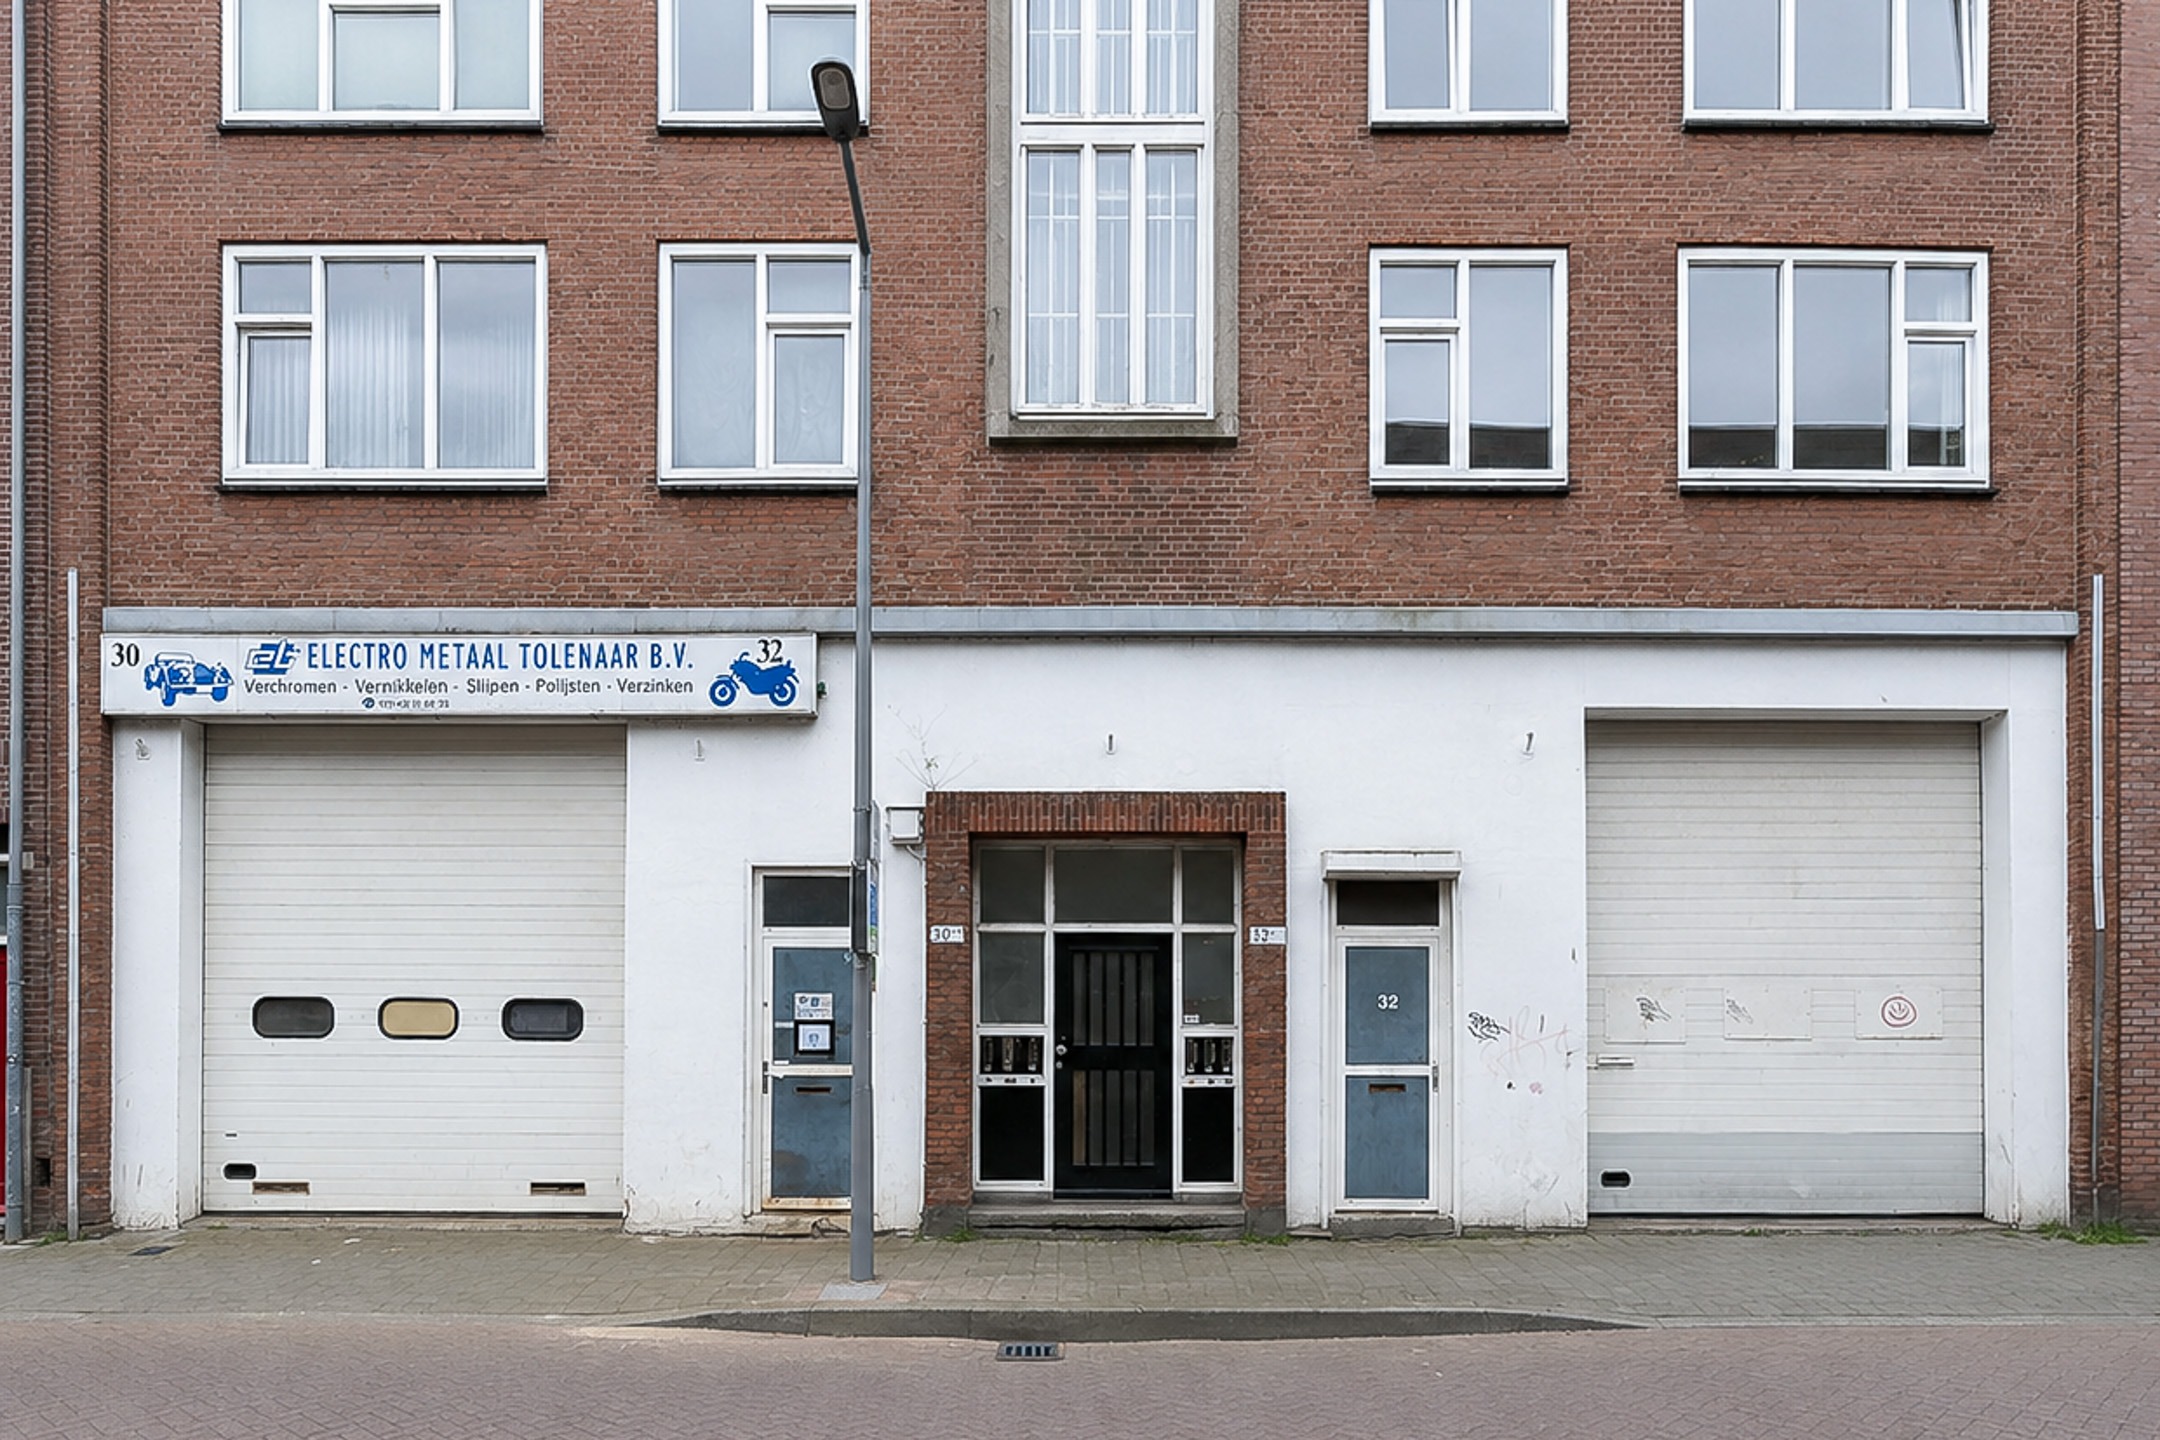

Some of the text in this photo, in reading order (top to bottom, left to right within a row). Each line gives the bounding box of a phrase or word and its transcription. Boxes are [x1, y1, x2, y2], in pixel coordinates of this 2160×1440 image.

[111, 643, 140, 667] 30
[308, 642, 693, 669] ELECTRO METAAL TOLENAAR B.V.
[757, 639, 783, 663] 32
[244, 678, 337, 694] Verchromen
[355, 678, 448, 694] Vernikkelen
[536, 678, 601, 696] Polijsten
[616, 678, 693, 693] Verzinken
[1377, 994, 1399, 1010] 32
